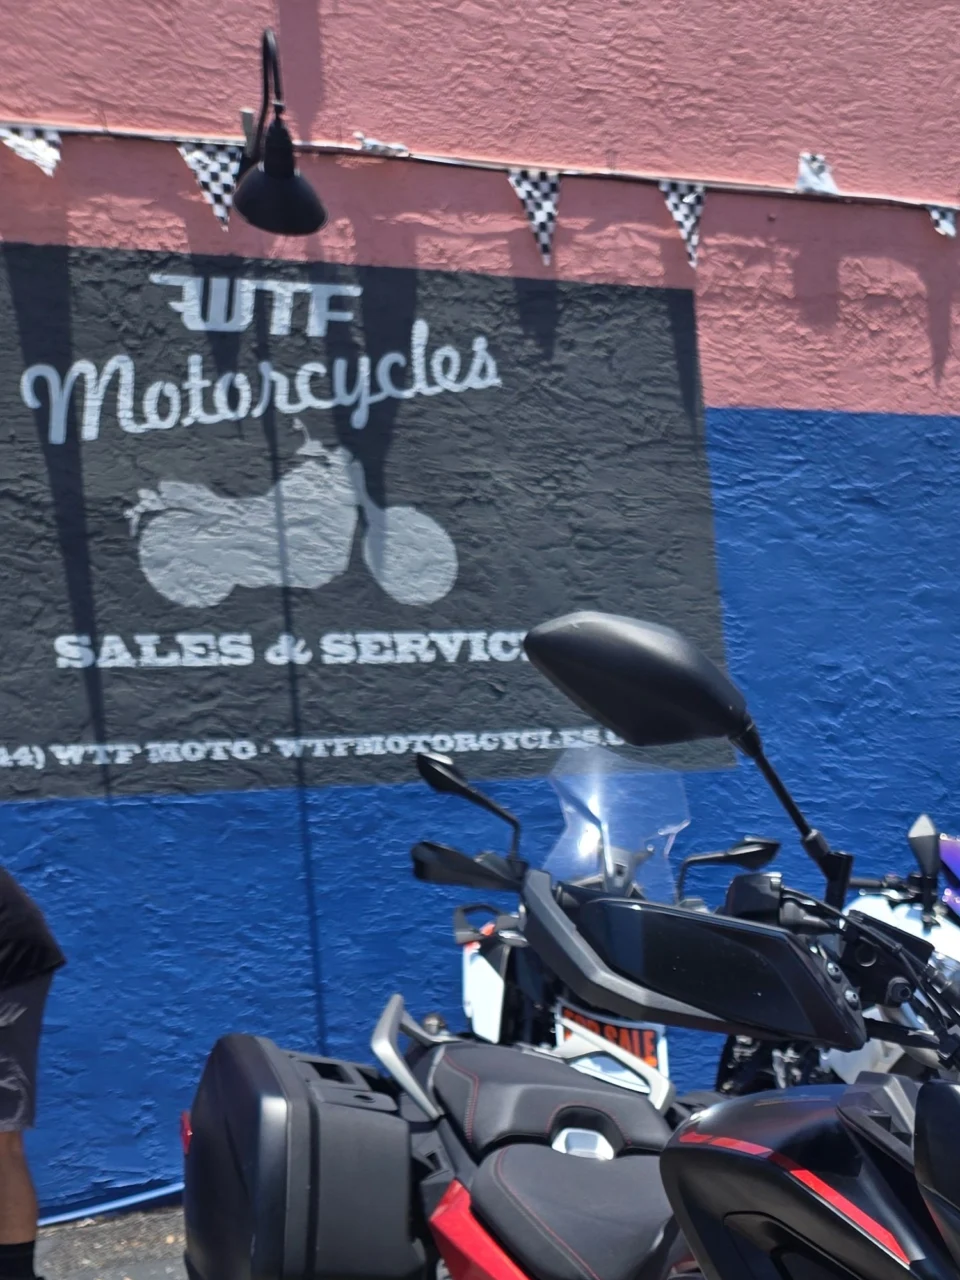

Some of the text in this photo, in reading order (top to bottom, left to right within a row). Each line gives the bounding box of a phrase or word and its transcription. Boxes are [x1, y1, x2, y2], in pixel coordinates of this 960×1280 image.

[148, 273, 363, 337] WTF
[20, 320, 502, 445] Motorcycles
[53, 631, 529, 668] SALES & SERVIC
[48, 742, 142, 765] WTF
[145, 739, 258, 764] MOTO
[273, 727, 626, 759] WTFMOTORCYCLES.C
